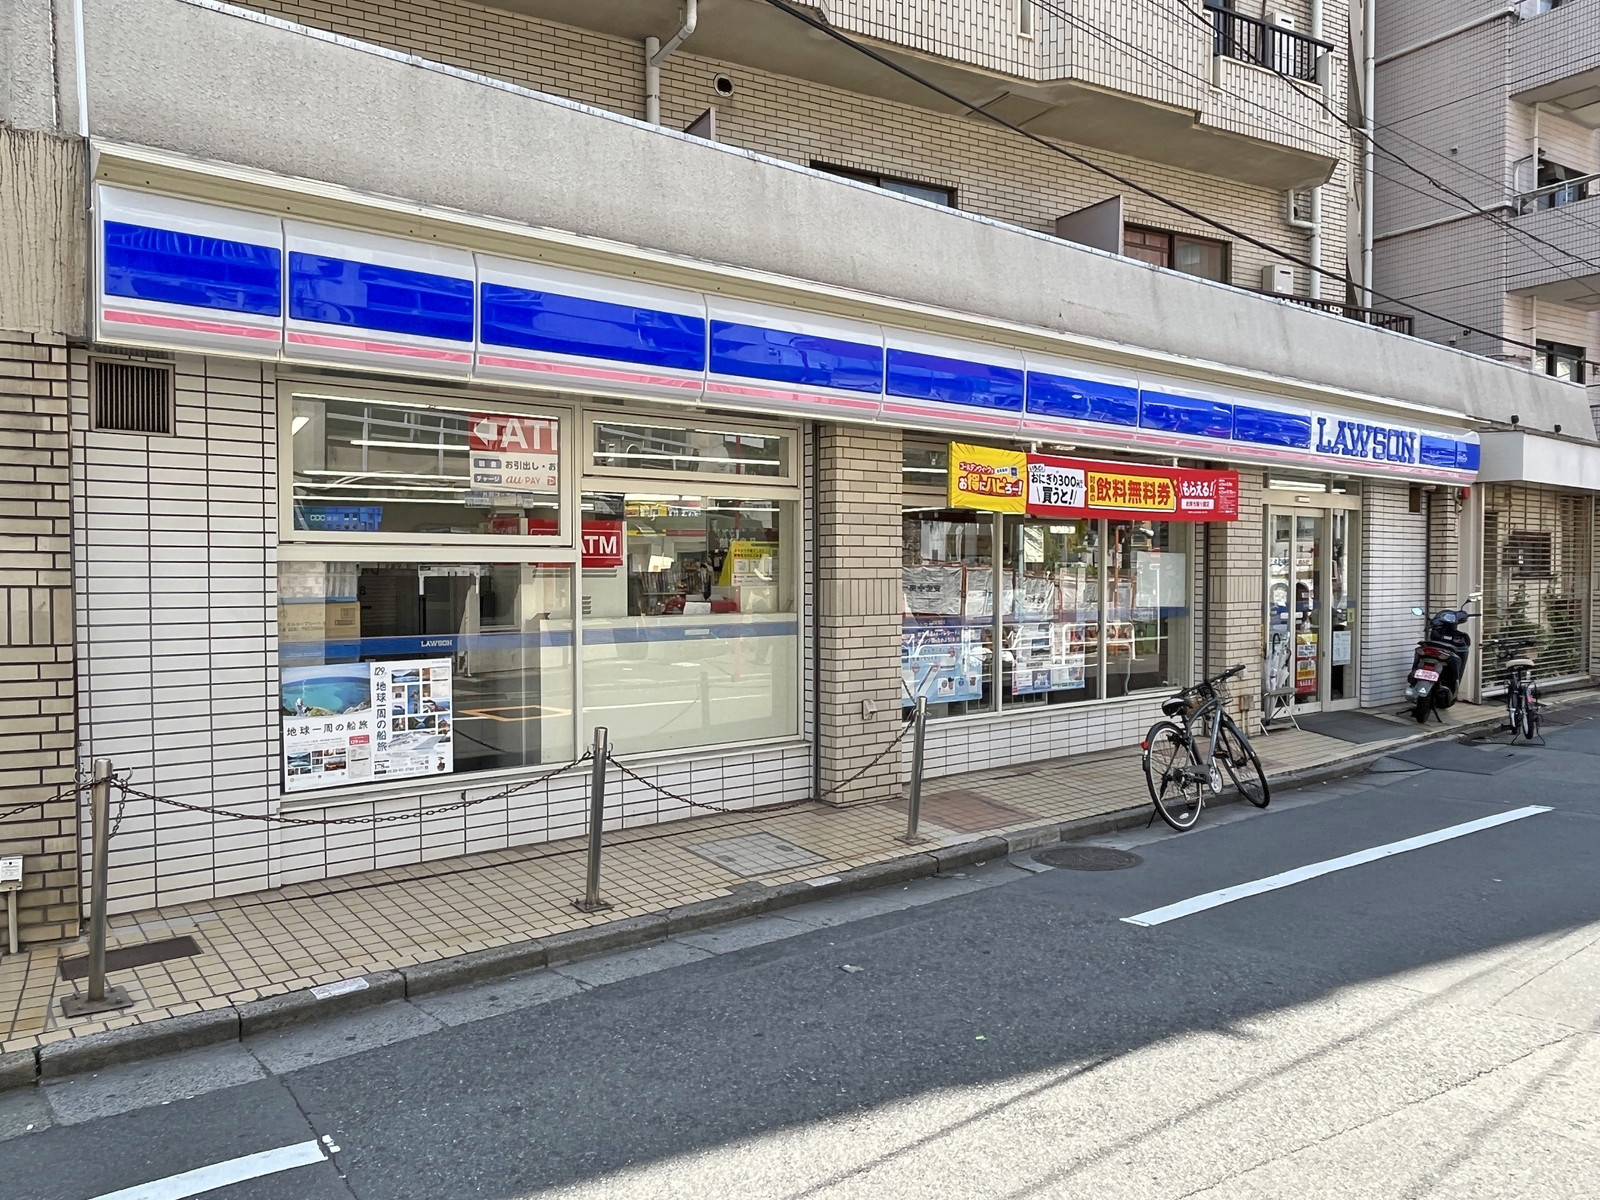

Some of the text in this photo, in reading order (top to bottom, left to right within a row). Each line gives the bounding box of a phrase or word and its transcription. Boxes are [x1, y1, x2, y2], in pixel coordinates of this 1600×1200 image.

[1315, 416, 1417, 464] LAWSON
[525, 476, 541, 485] PAY
[1096, 477, 1171, 506] 飲料無料券
[420, 639, 453, 648] LAWSON
[286, 719, 369, 737] 地球一周の船旅
[375, 681, 388, 752] 地球一周の船旅
